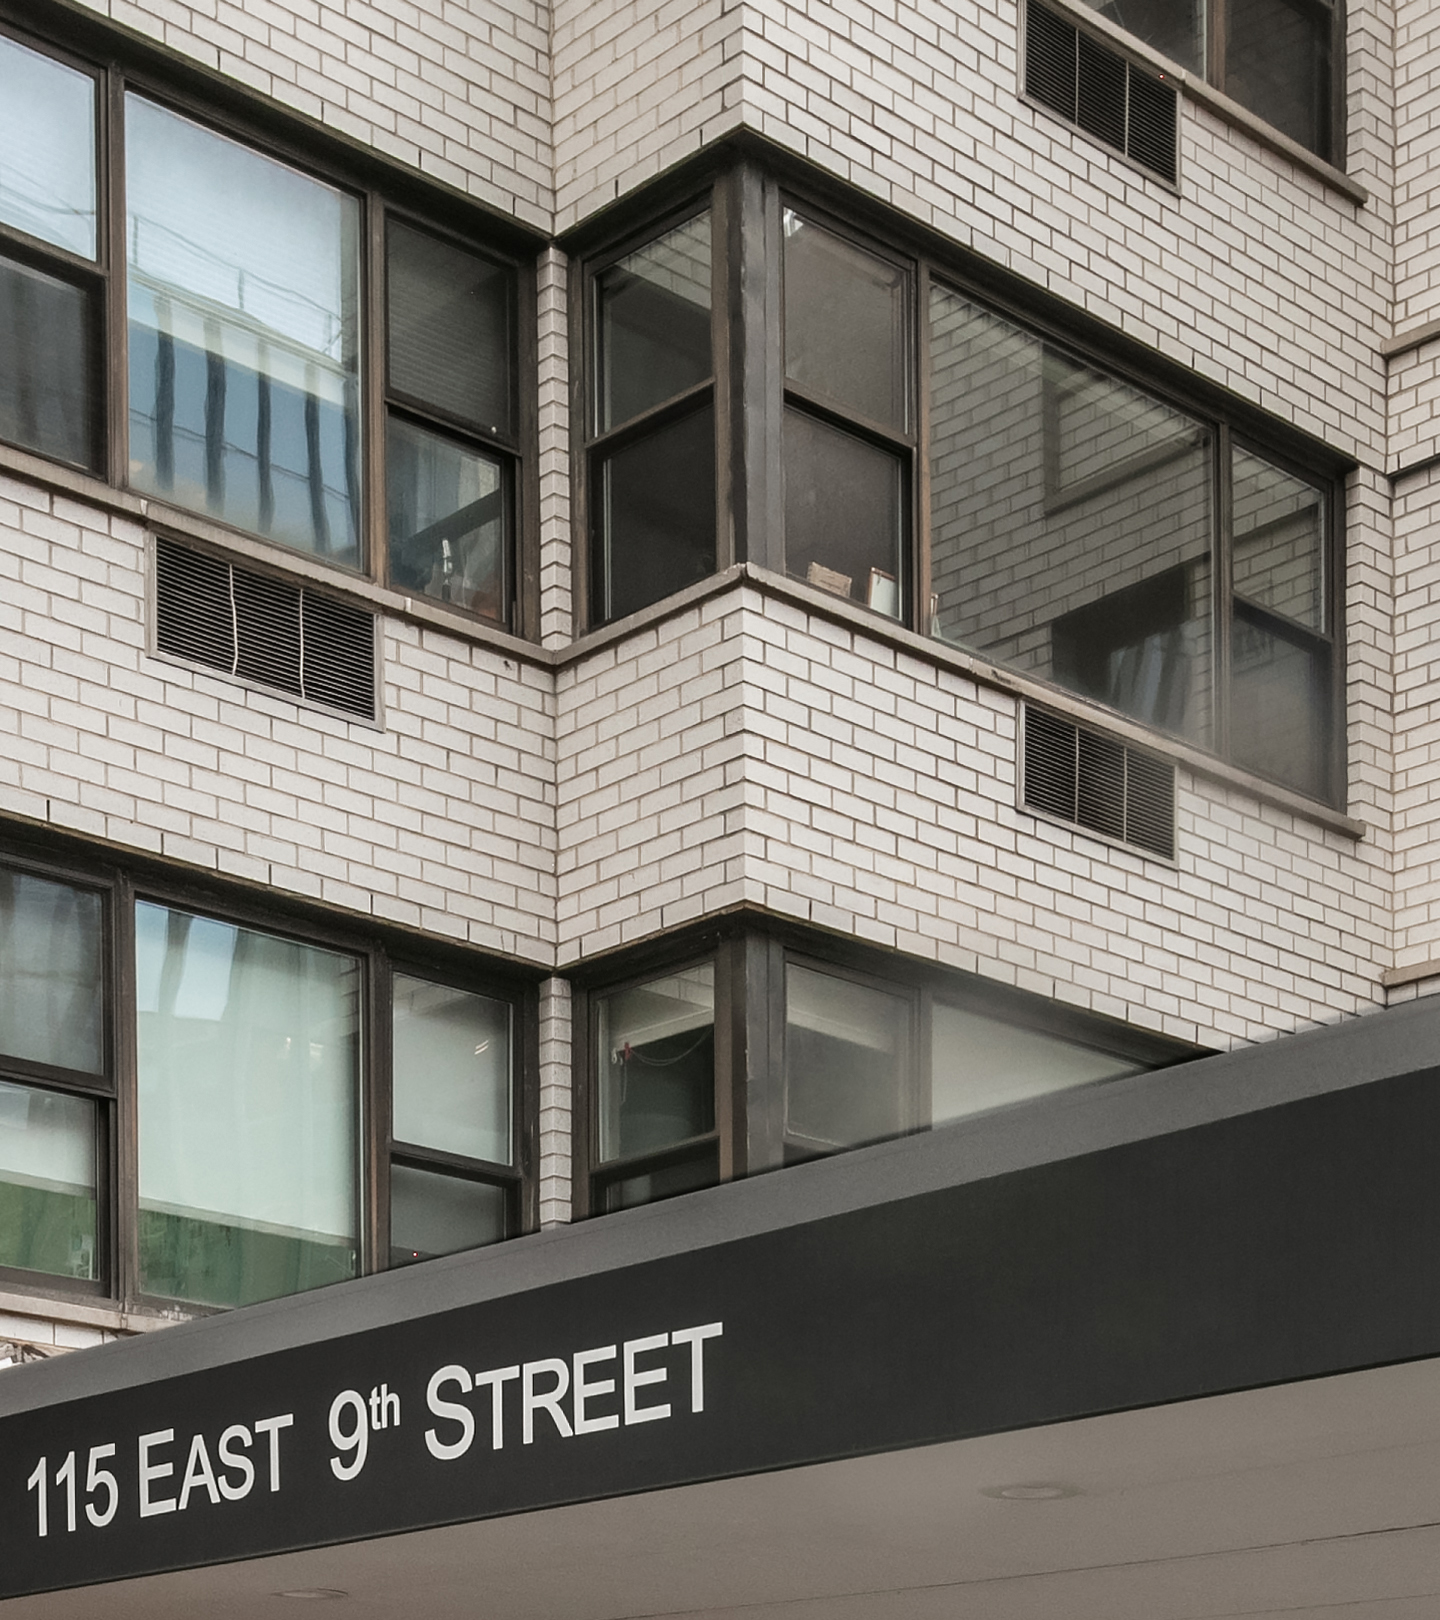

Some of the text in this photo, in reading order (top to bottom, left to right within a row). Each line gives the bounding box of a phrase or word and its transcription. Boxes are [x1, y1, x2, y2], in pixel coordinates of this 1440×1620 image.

[27, 1322, 723, 1537] 115 EAST 9th STREET
